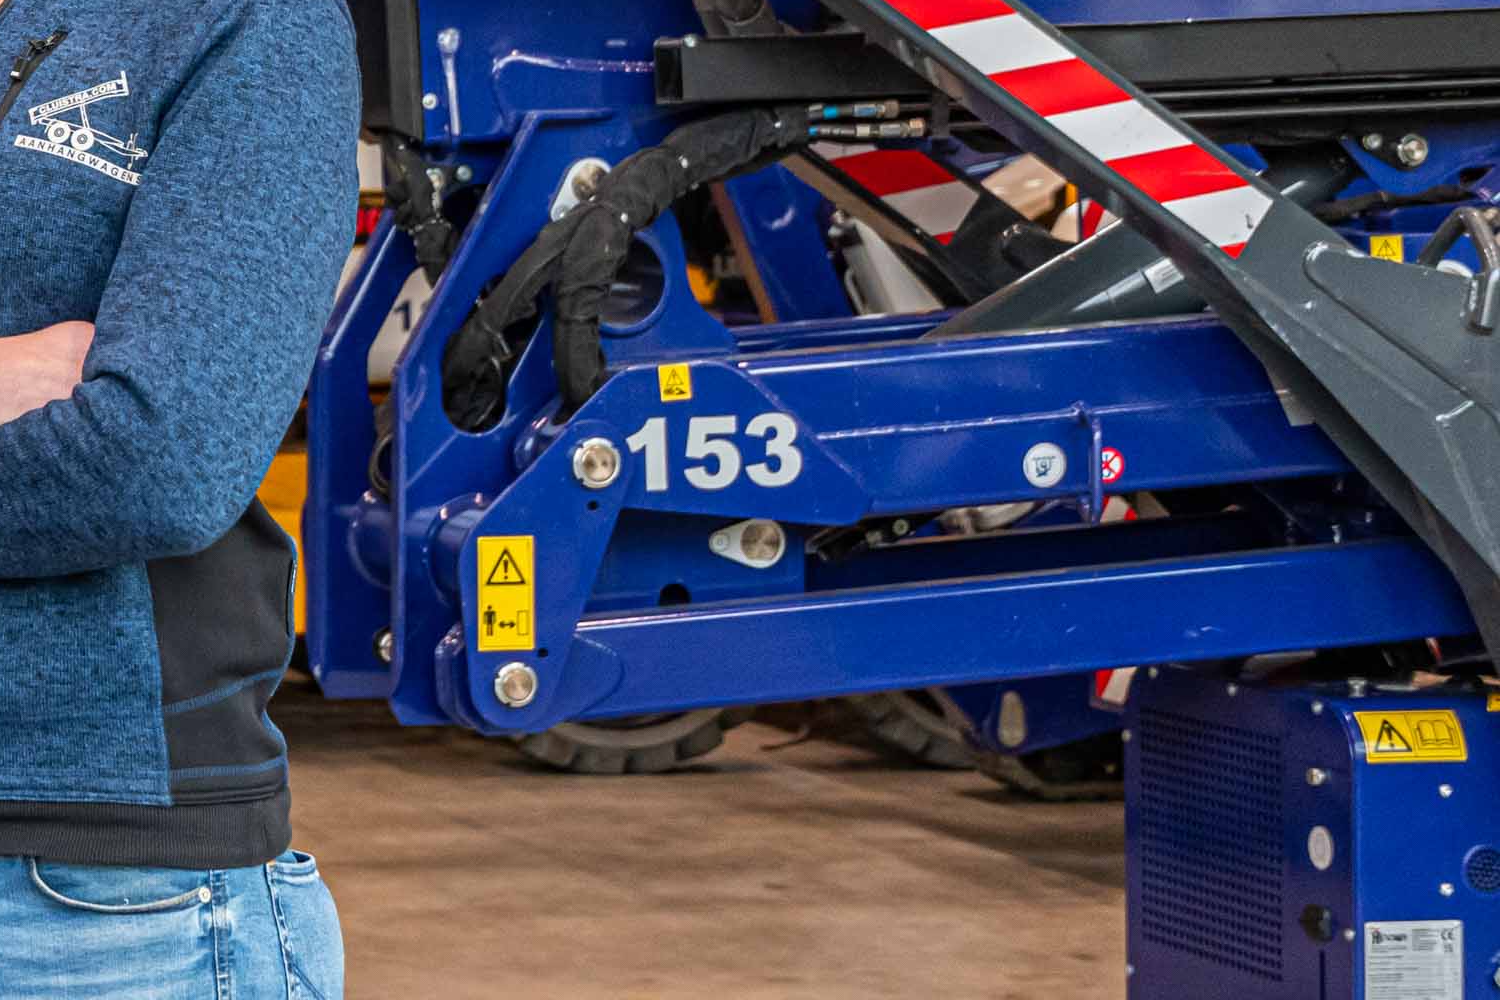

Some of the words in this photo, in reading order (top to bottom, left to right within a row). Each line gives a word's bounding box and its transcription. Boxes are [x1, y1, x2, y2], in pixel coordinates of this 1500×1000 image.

[39, 82, 118, 114] CLUISTRA.COM
[18, 137, 143, 184] AANHANGWAGENS
[625, 412, 803, 492] 153
